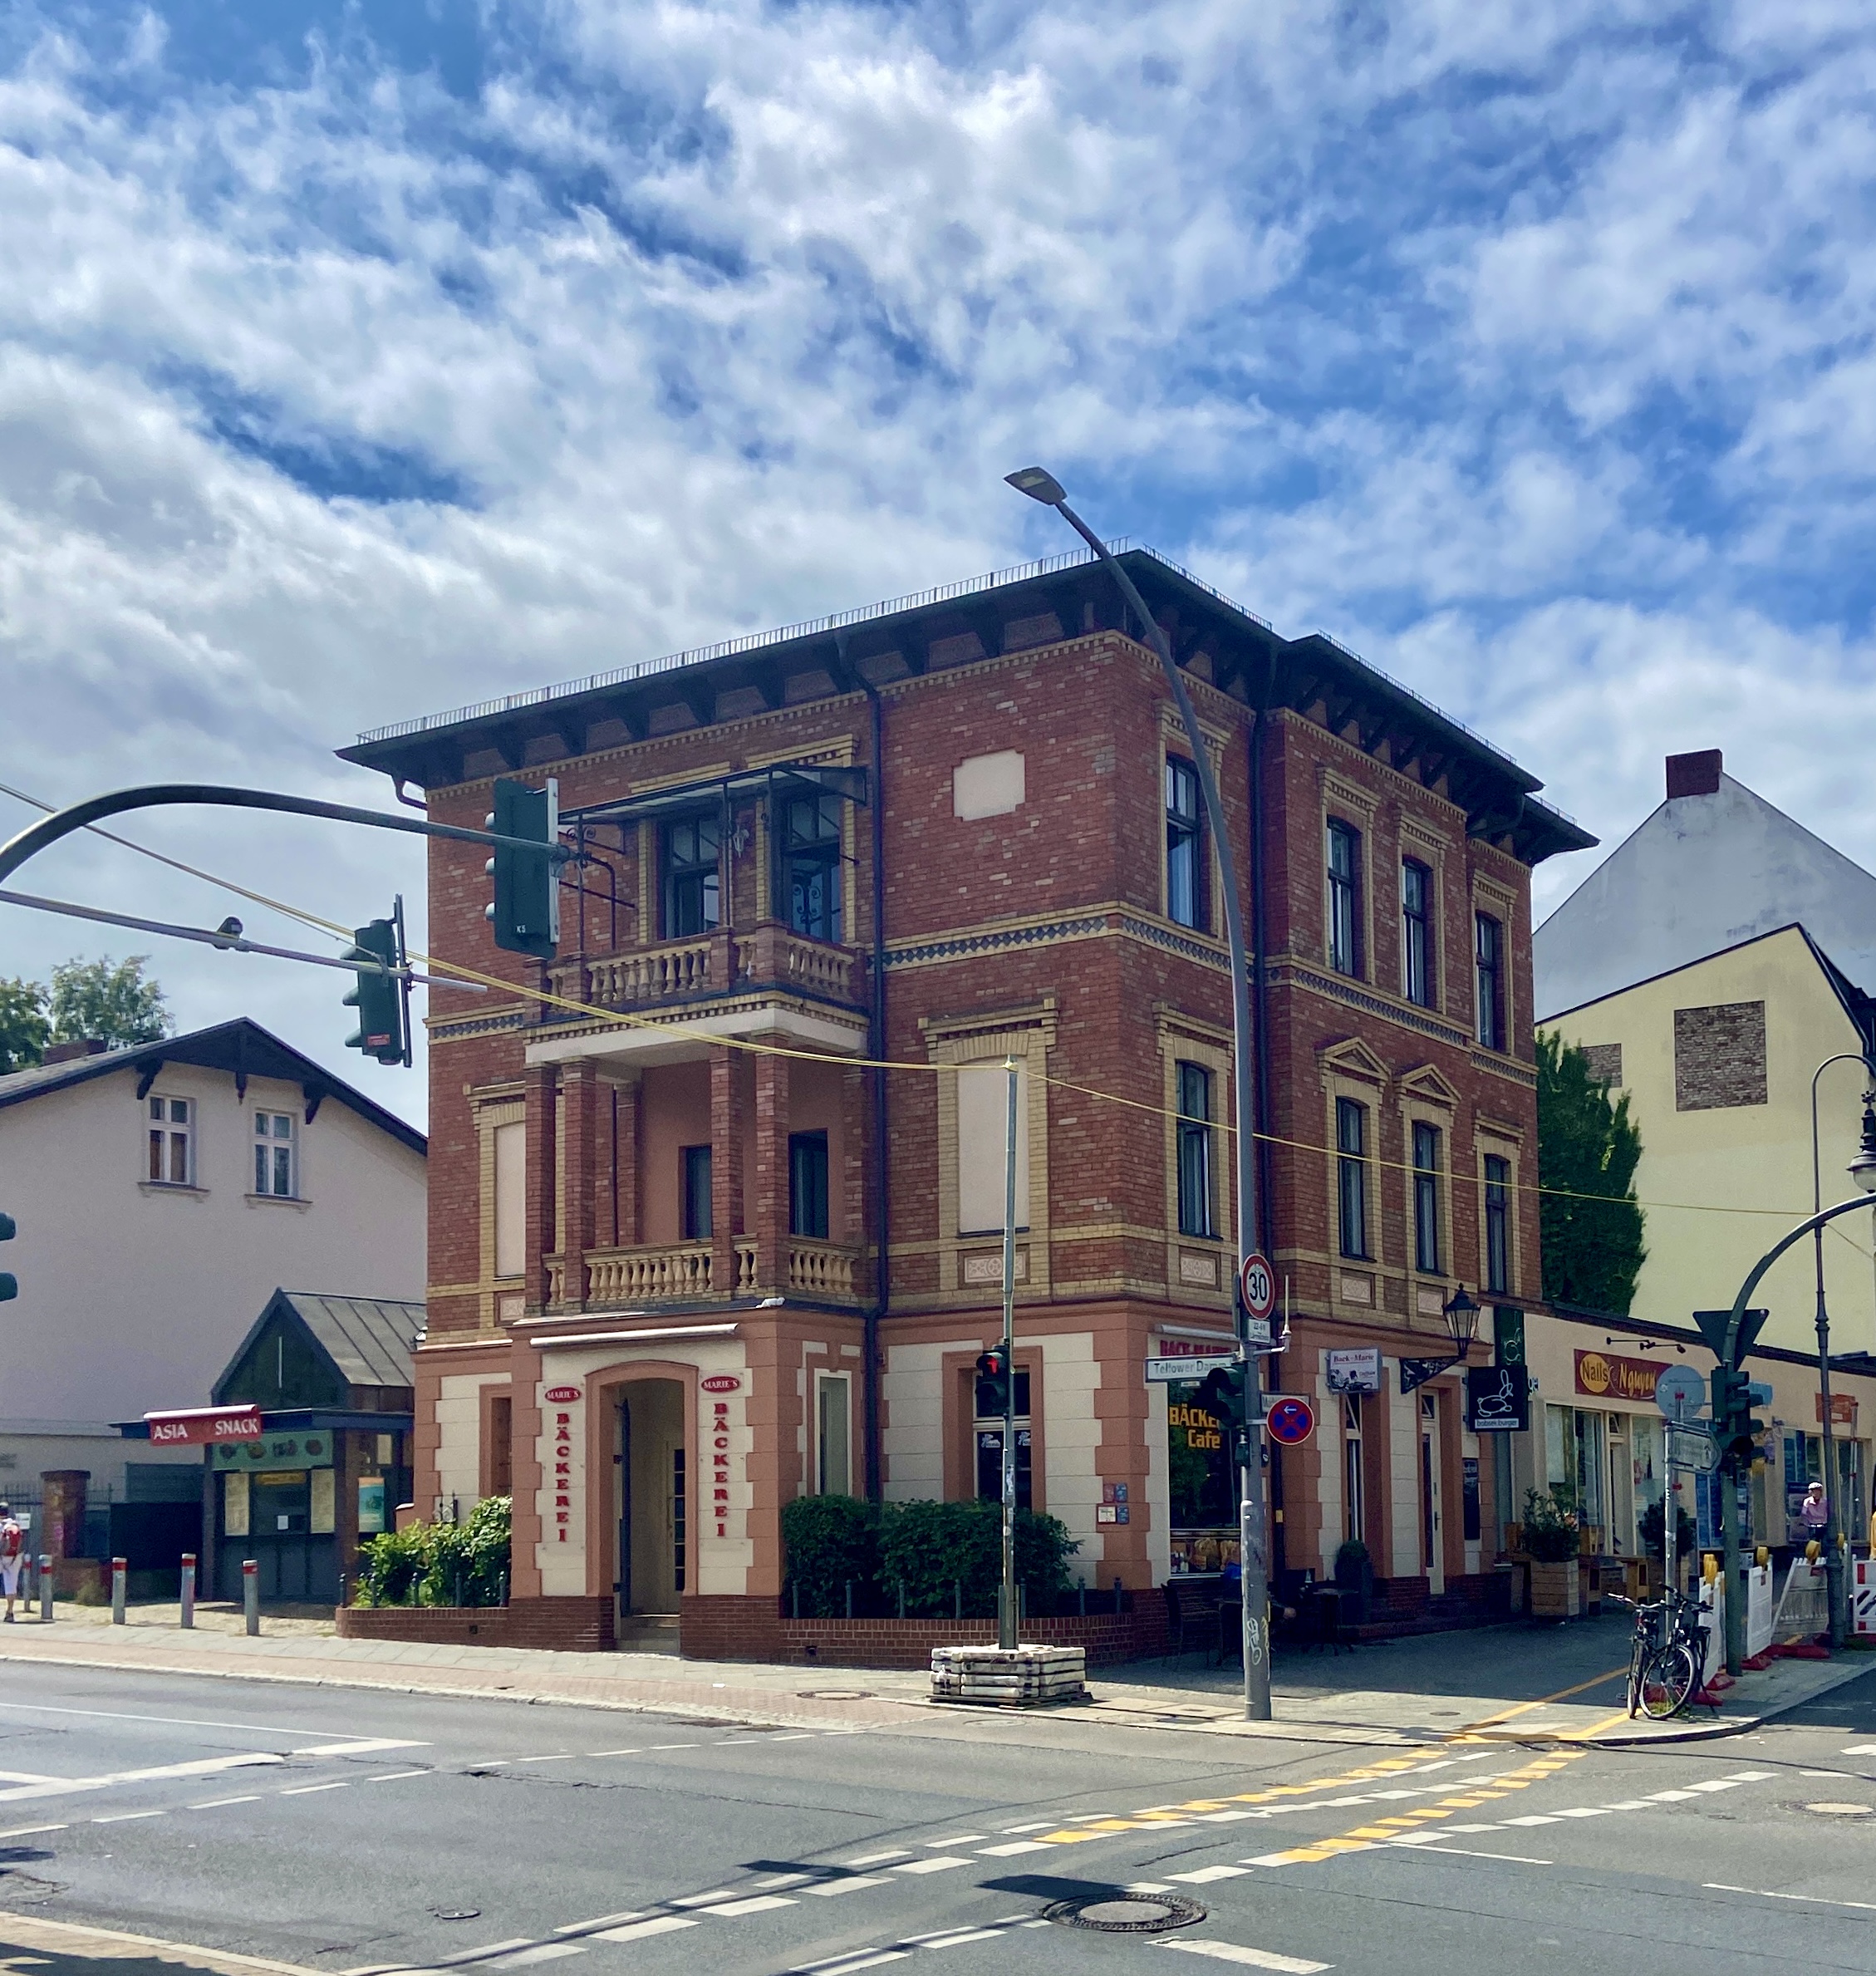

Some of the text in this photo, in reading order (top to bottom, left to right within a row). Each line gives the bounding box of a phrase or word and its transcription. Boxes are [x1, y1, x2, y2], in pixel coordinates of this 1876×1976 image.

[1249, 1272, 1268, 1301] 30
[1619, 1363, 1657, 1397] Nguyen
[154, 1418, 258, 1440] ASIA SNACK
[1169, 1403, 1220, 1428] BÄCKE
[1188, 1429, 1220, 1448] Cafe
[554, 1413, 571, 1542] BÄCKEREI
[713, 1403, 729, 1536] BÄCKEREI
